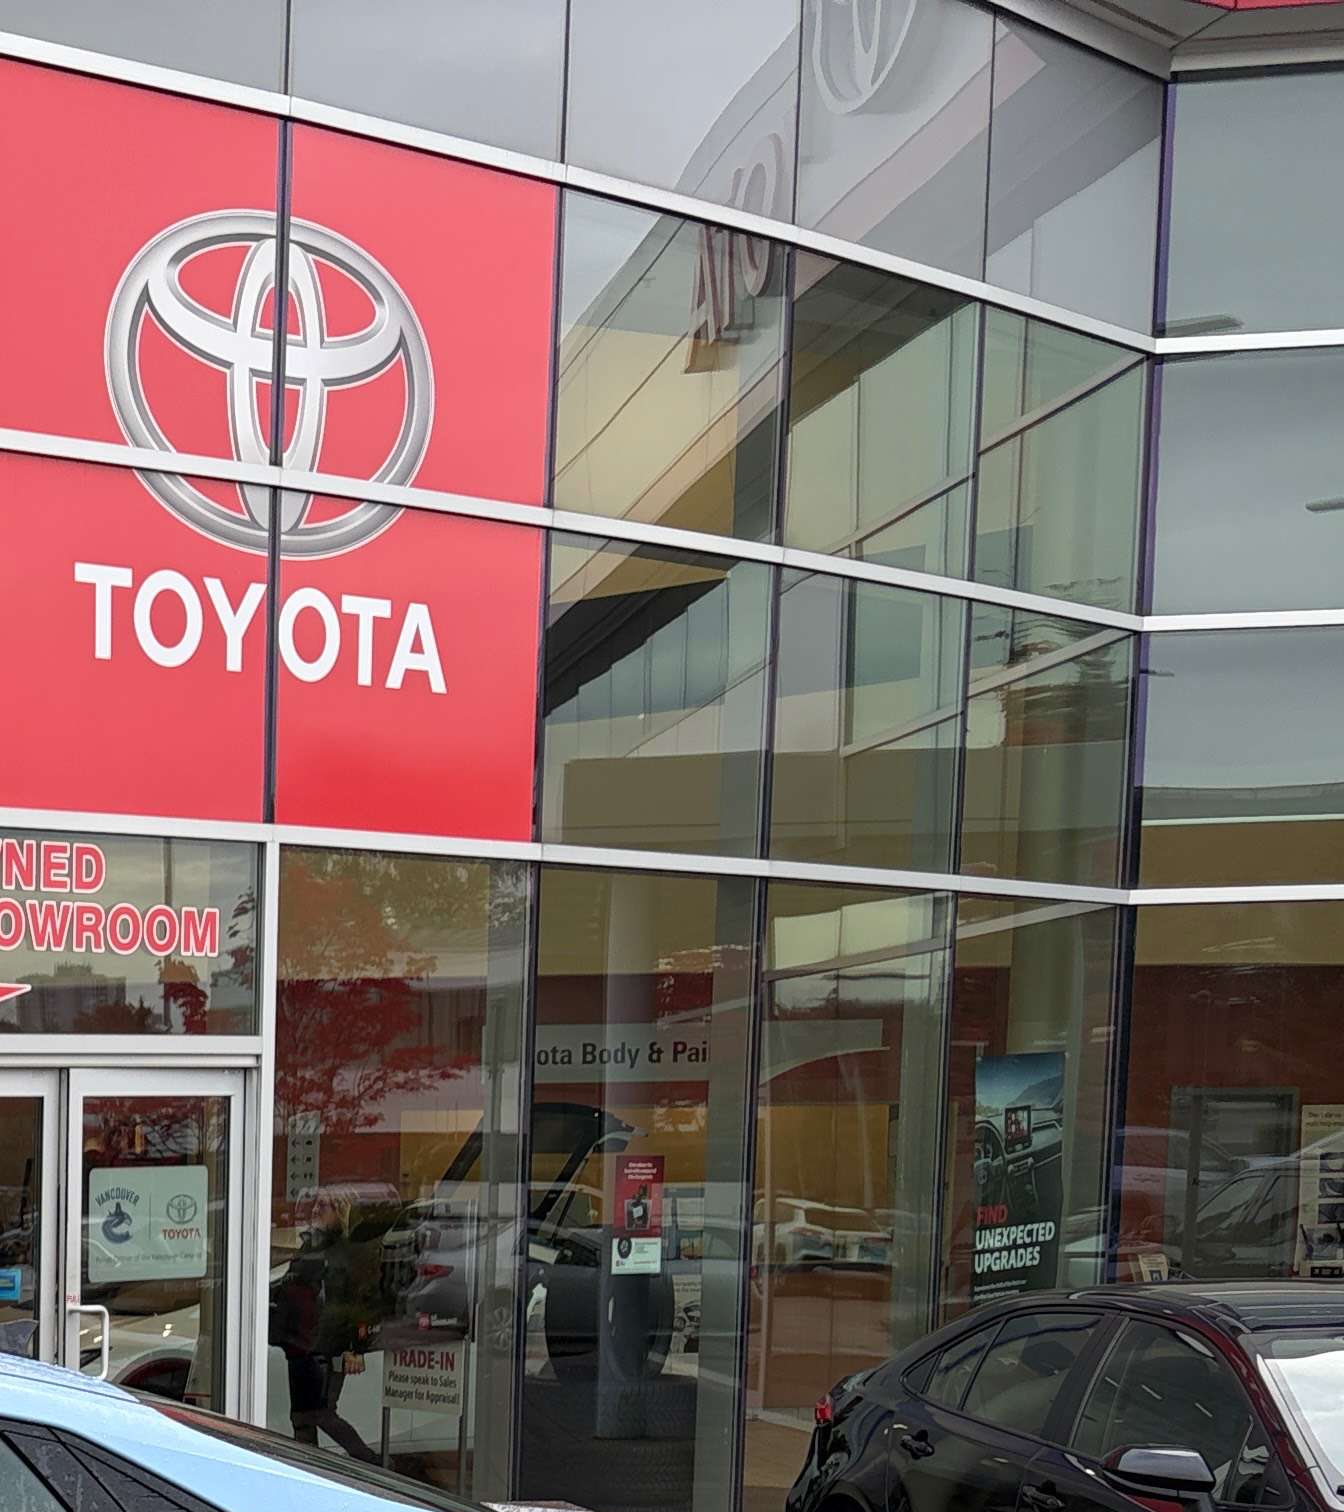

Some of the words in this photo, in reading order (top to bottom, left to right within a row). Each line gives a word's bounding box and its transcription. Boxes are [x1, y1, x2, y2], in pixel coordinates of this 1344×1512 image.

[74, 561, 448, 695] TOYOTA
[581, 1042, 640, 1069] Body
[647, 1041, 665, 1064] &
[672, 1040, 711, 1063] Pai
[95, 1187, 140, 1207] VANCOUVER
[976, 1204, 1008, 1226] FIND
[161, 1228, 201, 1240] TOYOTA
[975, 1221, 1055, 1250] UNEXPECTED
[974, 1246, 1040, 1274] UPGRADES
[393, 1350, 455, 1371] TRADE-IN
[388, 1370, 410, 1384] Please
[411, 1373, 430, 1386] speak
[430, 1375, 438, 1386] to
[439, 1375, 457, 1388] Sales
[385, 1386, 413, 1402] Manager
[415, 1389, 426, 1401] for
